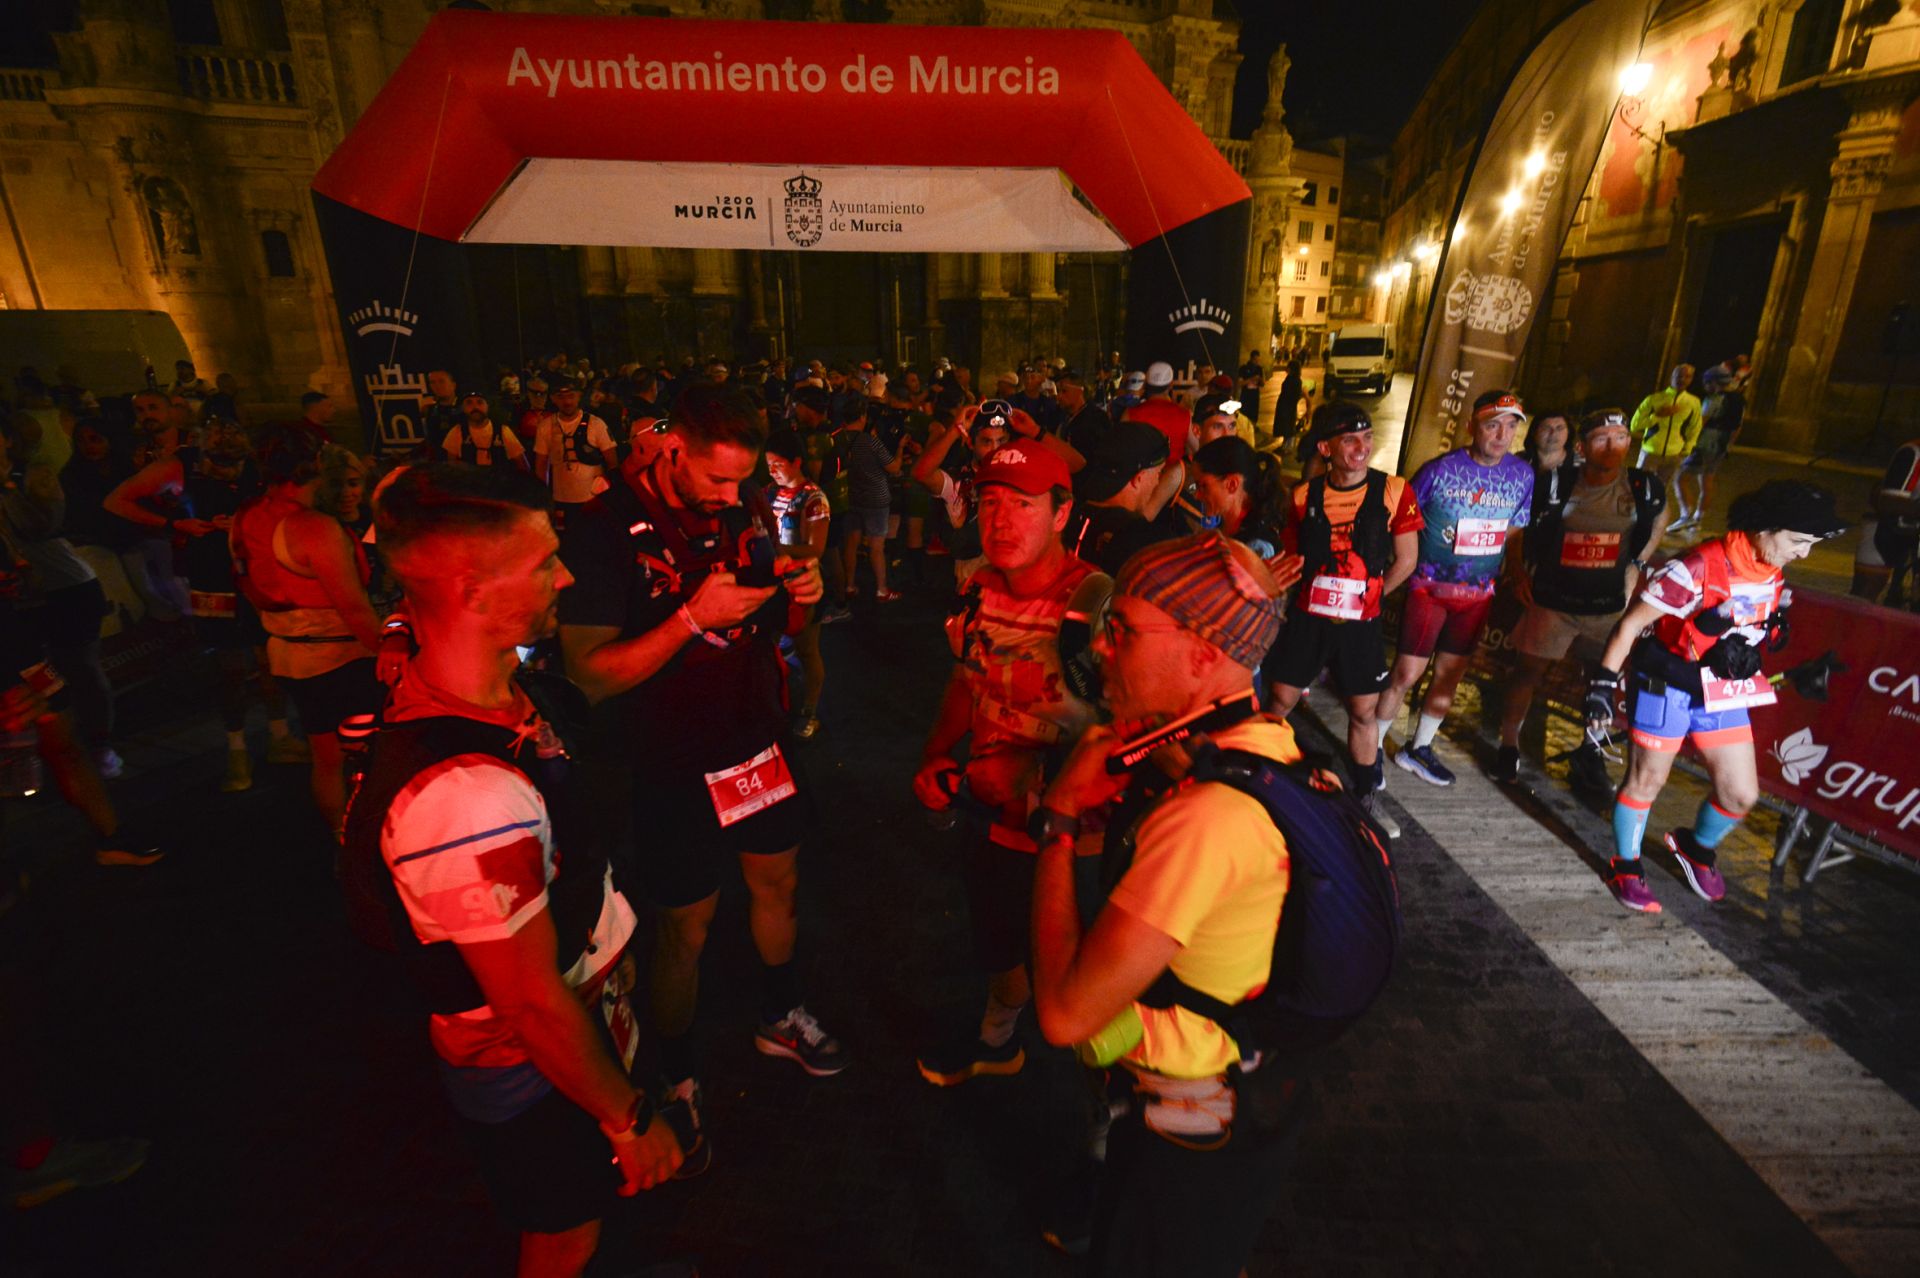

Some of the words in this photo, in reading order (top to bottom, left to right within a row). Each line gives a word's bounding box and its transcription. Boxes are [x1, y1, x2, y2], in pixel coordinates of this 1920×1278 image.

[506, 47, 826, 98] Ayuntamiento
[840, 54, 894, 94] de
[909, 55, 1060, 95] Murcia
[716, 196, 754, 205] 1200
[829, 199, 925, 217] Ayuntamiento
[674, 205, 756, 219] MURCIA
[1512, 246, 1530, 270] de
[1522, 151, 1568, 237] Murcia
[829, 218, 847, 232] de
[850, 218, 903, 232] Murcia
[1437, 369, 1459, 418] 1200
[1438, 370, 1475, 454] URCIA
[1470, 533, 1496, 546] 429
[1723, 678, 1756, 697] 479
[736, 771, 764, 797] 84
